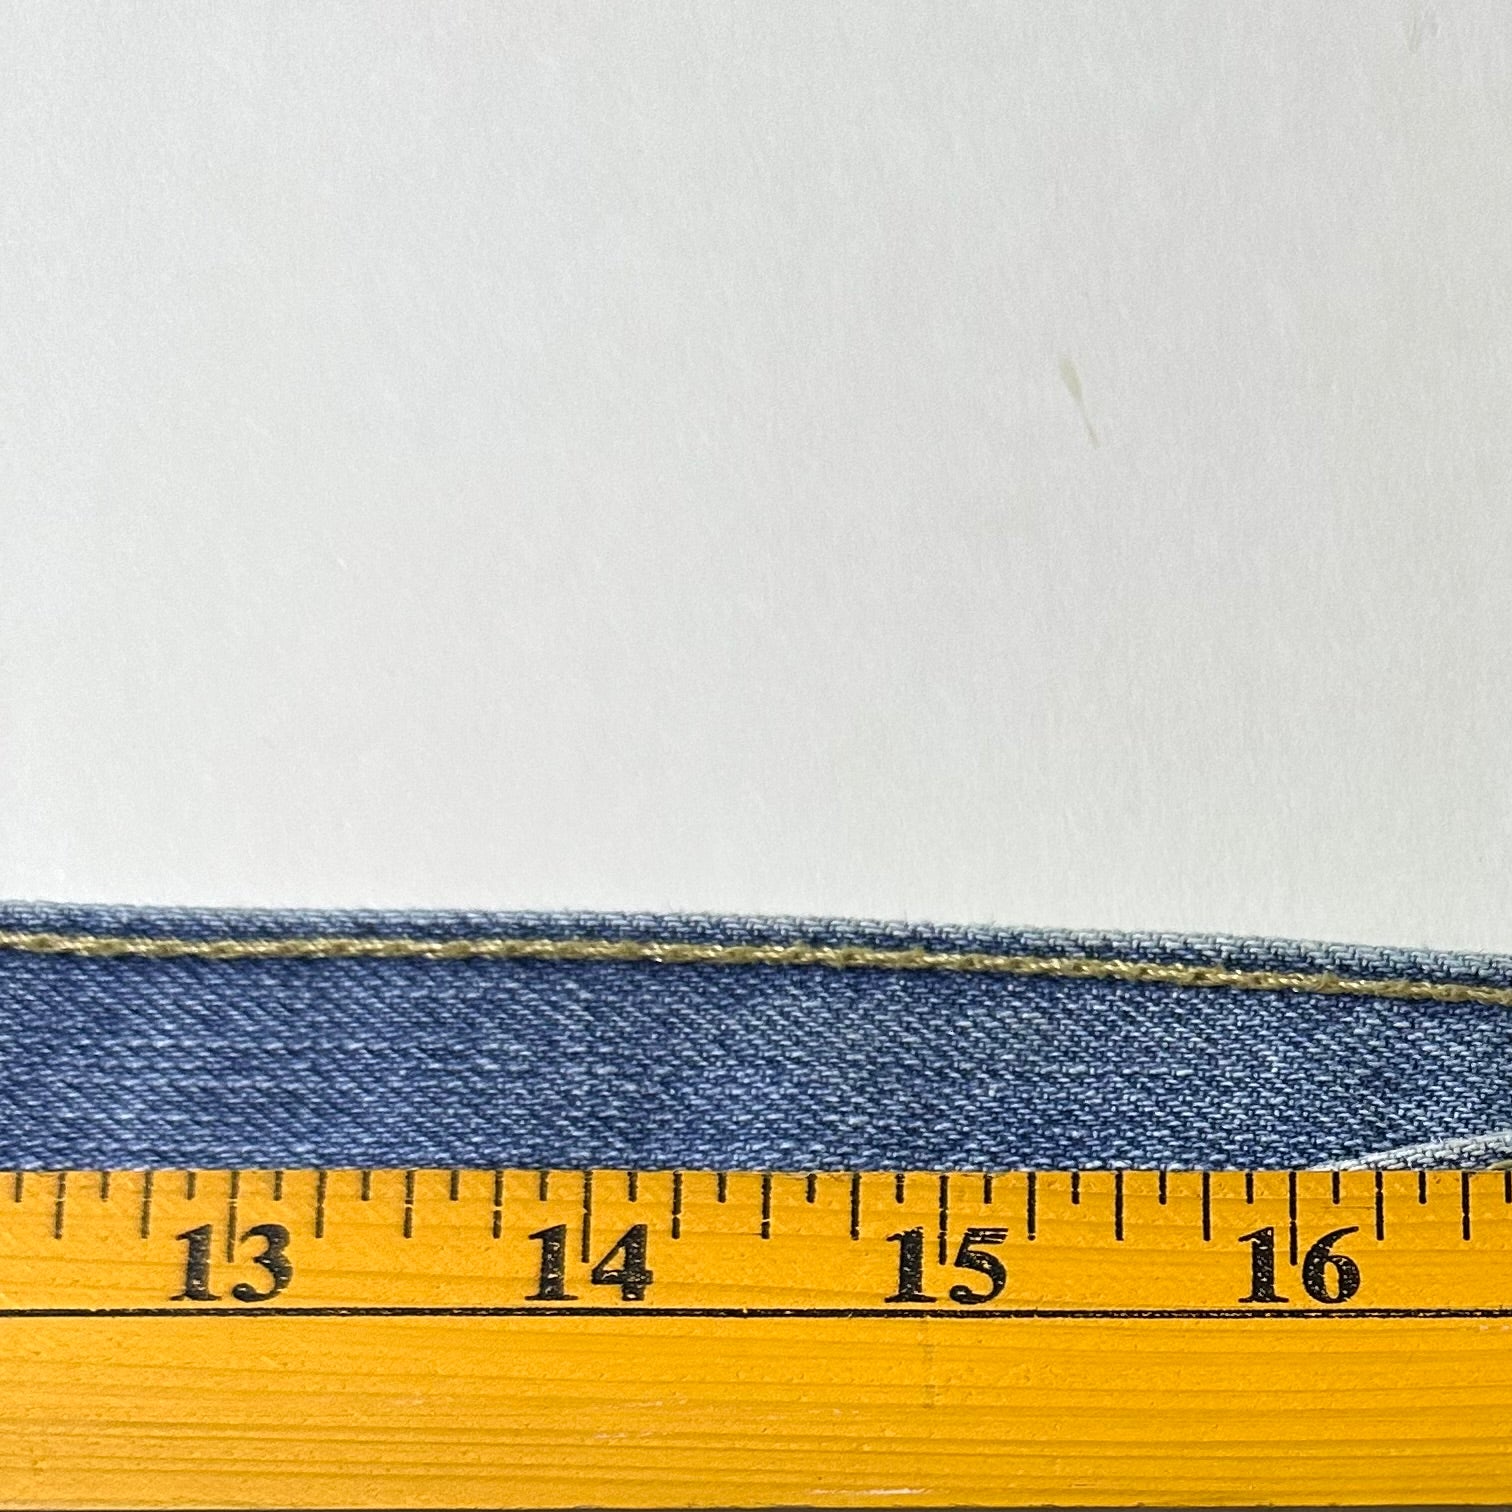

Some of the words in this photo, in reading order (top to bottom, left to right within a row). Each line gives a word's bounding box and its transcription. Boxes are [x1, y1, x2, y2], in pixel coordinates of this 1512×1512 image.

[170, 1224, 293, 1302] 13
[525, 1224, 653, 1302] 14
[884, 1226, 1009, 1304] 15
[1238, 1226, 1361, 1304] 16
